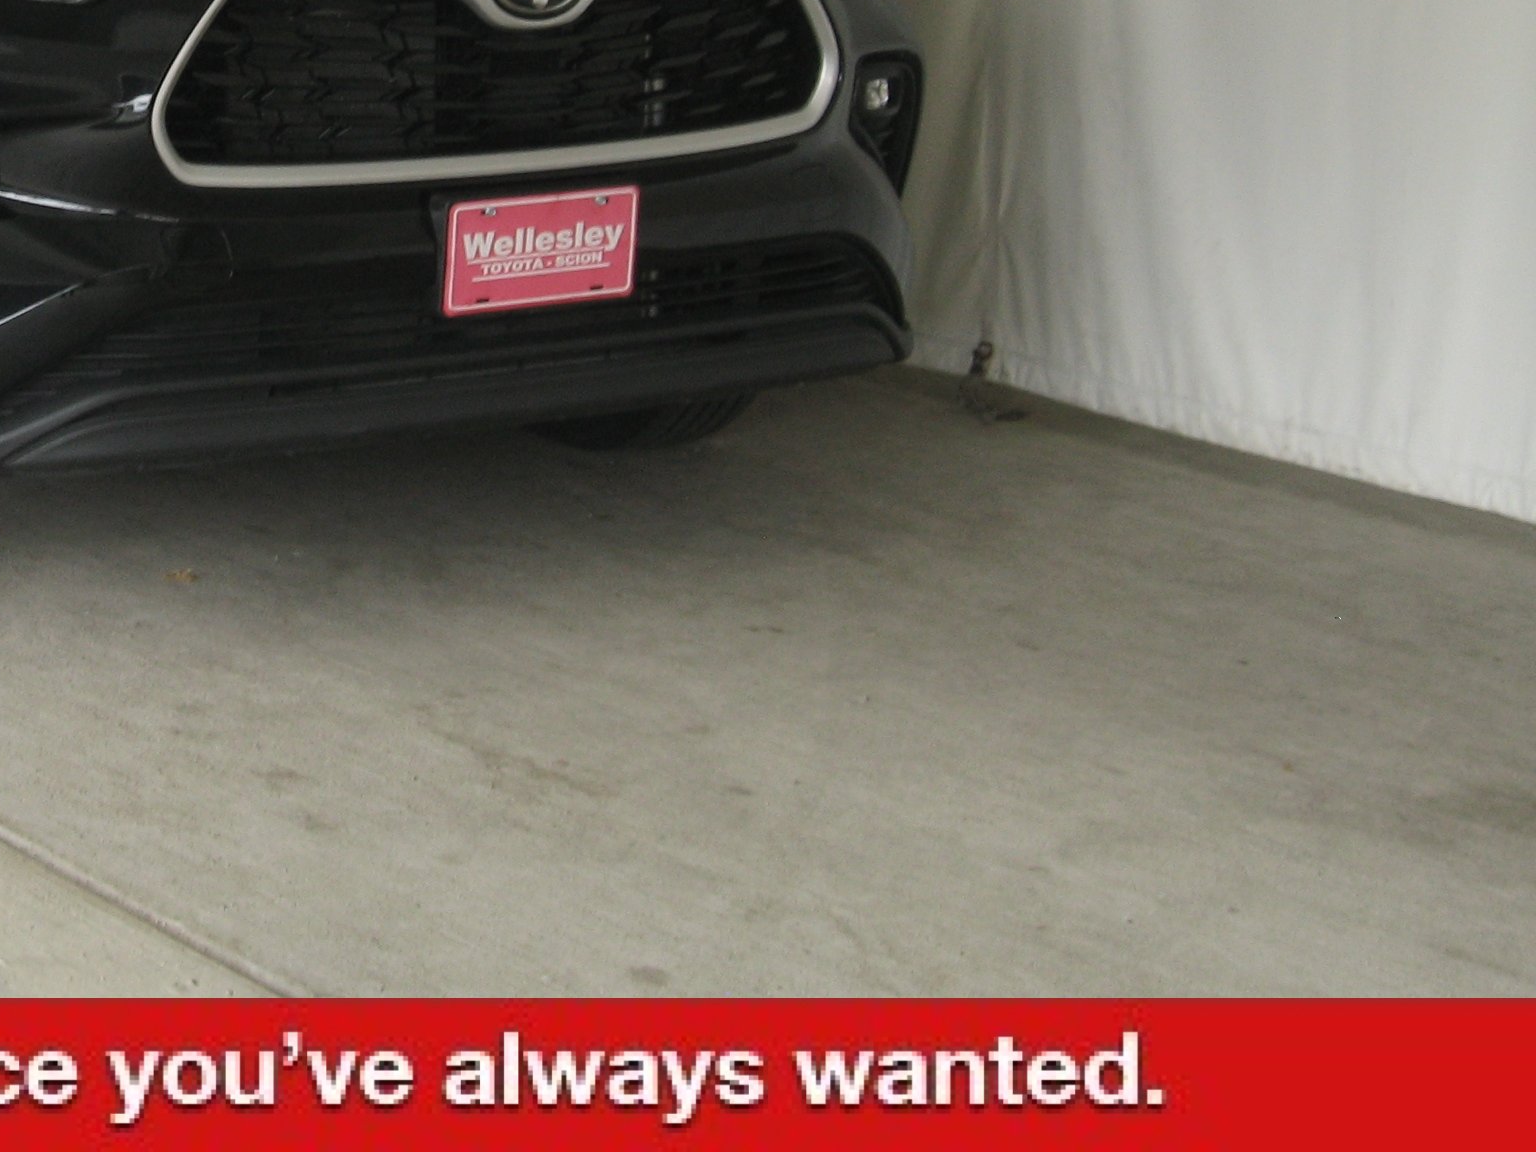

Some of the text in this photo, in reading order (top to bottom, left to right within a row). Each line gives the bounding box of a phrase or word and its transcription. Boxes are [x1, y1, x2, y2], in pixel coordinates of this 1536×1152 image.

[464, 221, 625, 260] Wellesley
[481, 257, 544, 275] TOYOTA
[555, 250, 602, 268] SCION
